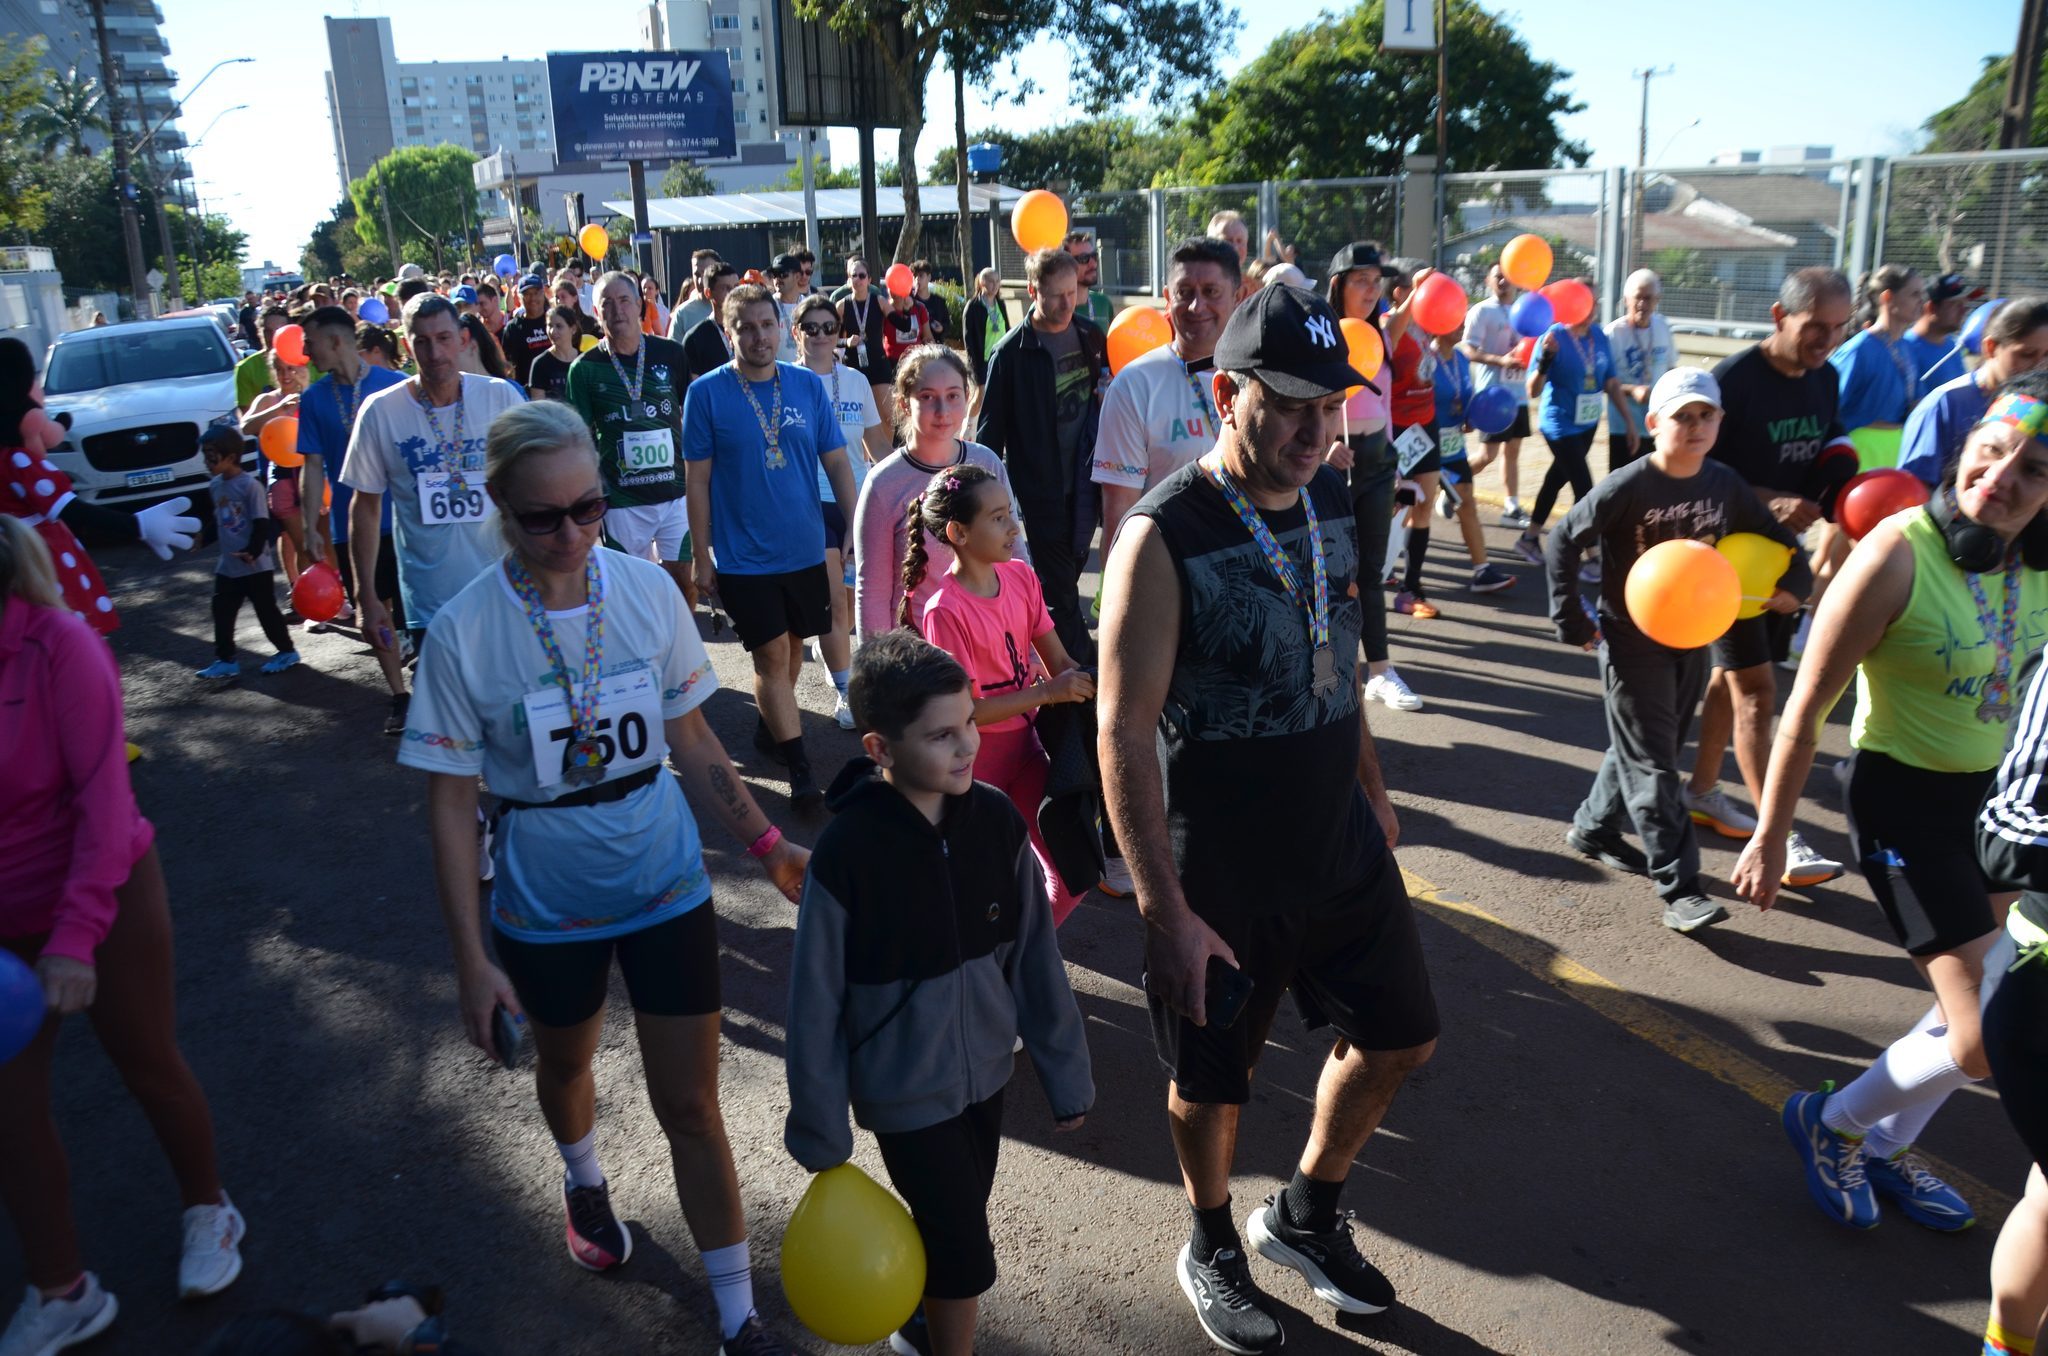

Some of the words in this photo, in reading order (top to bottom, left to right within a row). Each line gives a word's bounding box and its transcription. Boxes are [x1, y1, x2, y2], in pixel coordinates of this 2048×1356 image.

[580, 60, 701, 93] PBNEW
[611, 91, 704, 106] SISTEMAS
[604, 113, 637, 123] Soluções
[639, 110, 685, 121] tecnológicas
[618, 122, 650, 131] produtos
[632, 444, 669, 466] 300
[1397, 436, 1427, 467] 843
[1780, 440, 1821, 463] PRO
[431, 490, 484, 519] 669
[1644, 501, 1691, 525] SKATE
[1193, 1278, 1213, 1311] FILA
